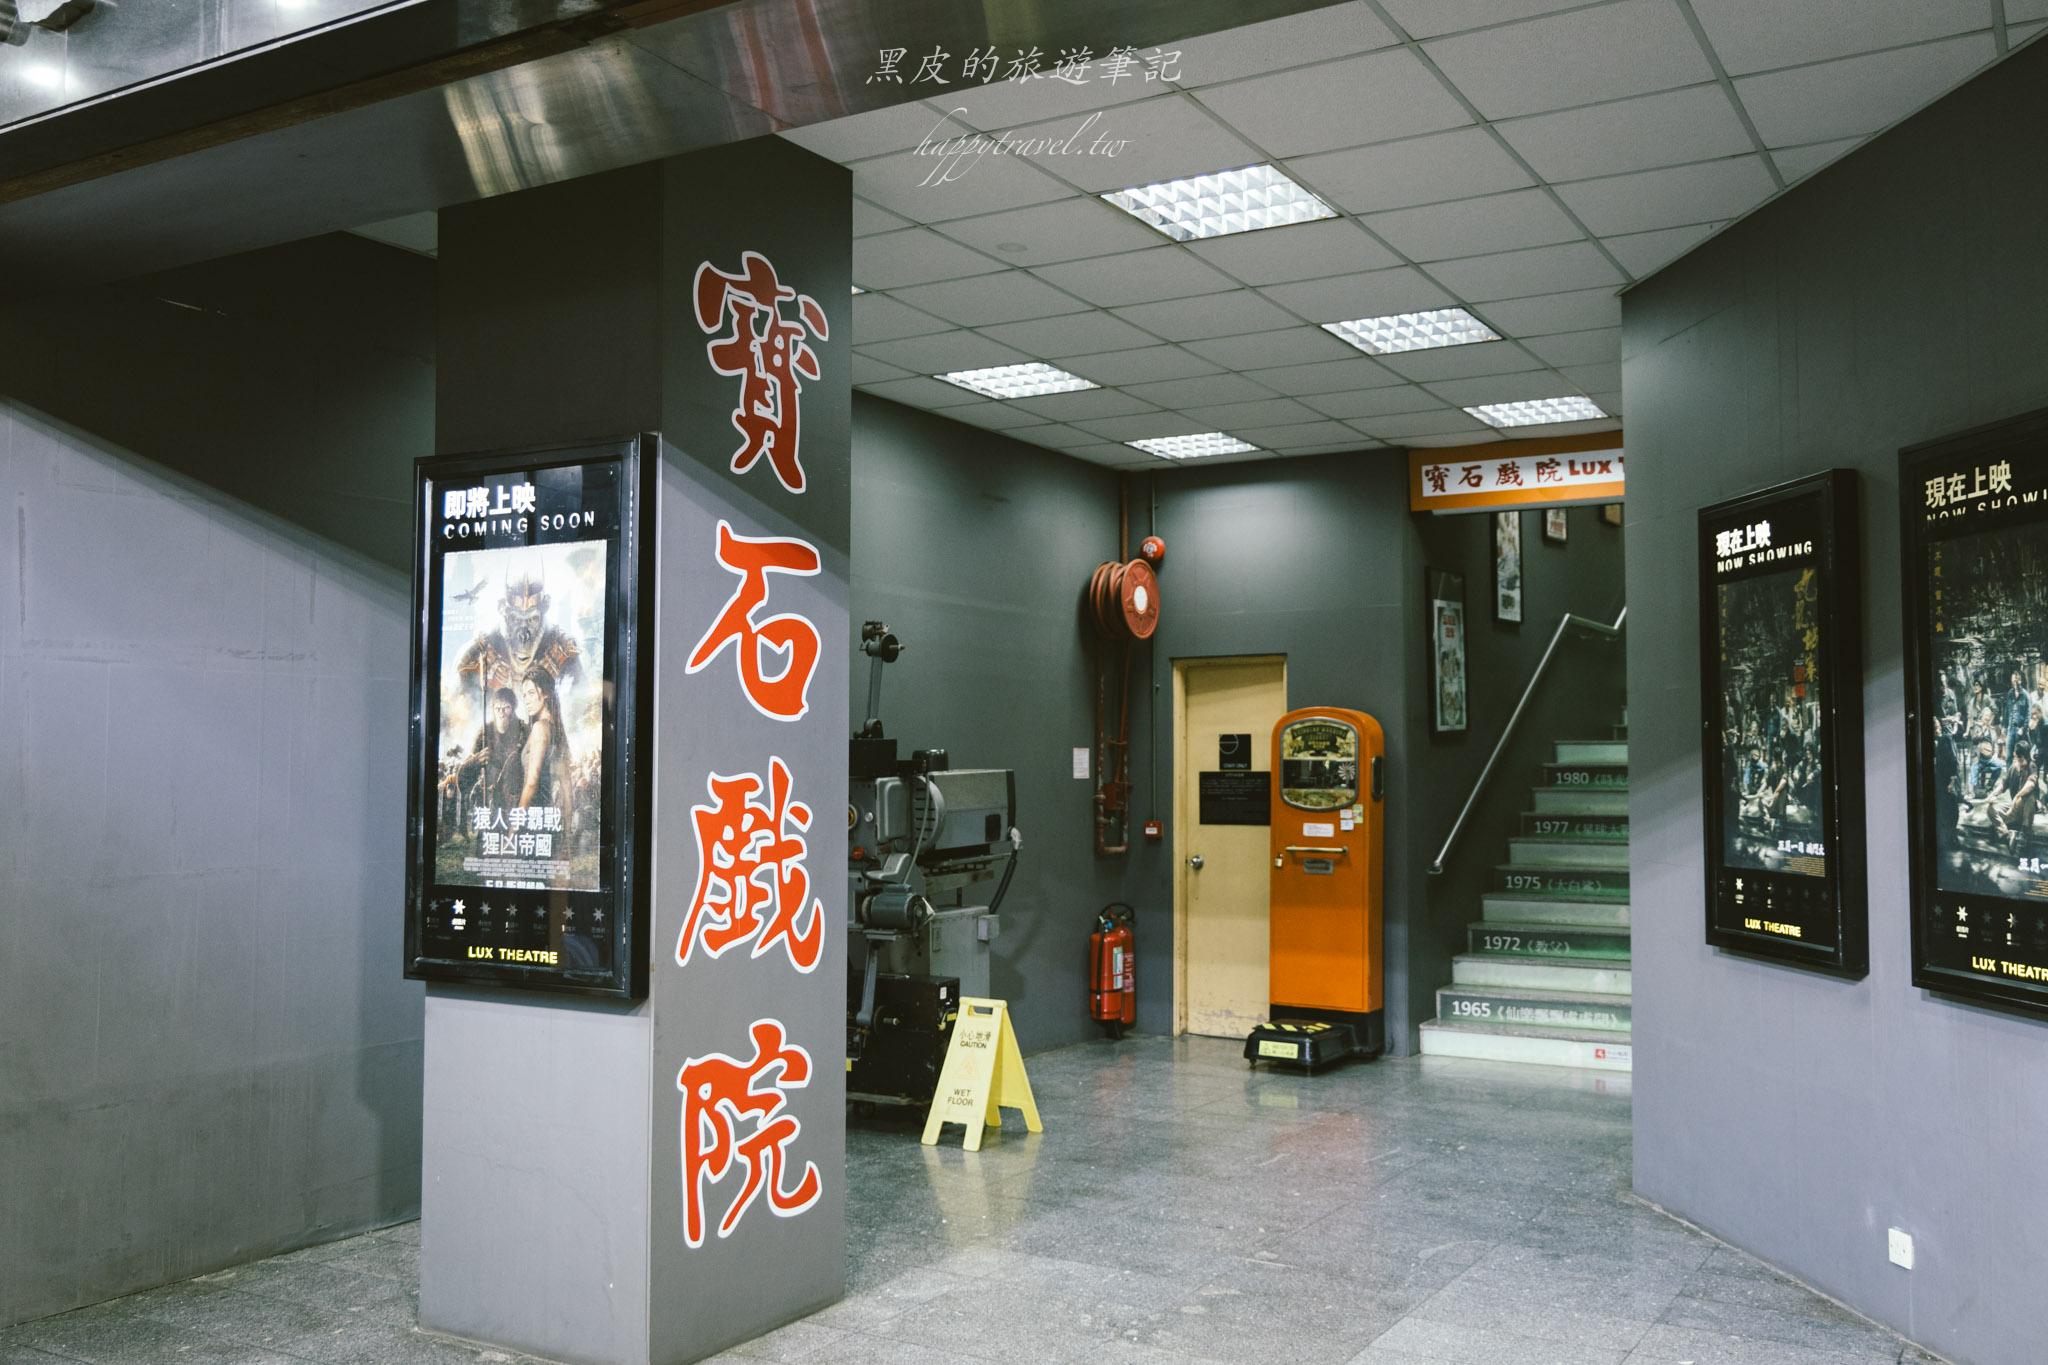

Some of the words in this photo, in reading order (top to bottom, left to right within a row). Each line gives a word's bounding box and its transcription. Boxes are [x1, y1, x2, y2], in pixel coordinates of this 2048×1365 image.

[1925, 460, 2012, 508] 現在上映
[444, 482, 536, 520] 即將上映
[444, 517, 528, 540] COMING
[540, 511, 595, 531] SOON
[1716, 520, 1771, 558] 現在上映
[1717, 556, 1743, 573] NOW
[1748, 541, 1813, 566] SHOWING
[1556, 772, 1590, 785] 1980
[473, 806, 562, 833] 猿人爭霸戰
[1534, 820, 1569, 834] 1977
[1505, 875, 1541, 889] 1975
[1744, 918, 1761, 930] LUX
[1763, 921, 1802, 937] THEATRE
[1483, 936, 1521, 951] 1972
[467, 946, 493, 959] LUX
[499, 948, 558, 964] THEATRE
[1972, 956, 1996, 972] LUX
[1452, 1000, 1491, 1018] 1965
[960, 1041, 987, 1049] CAUTION
[947, 1097, 974, 1106] FLOOR
[954, 1088, 972, 1097] WET
